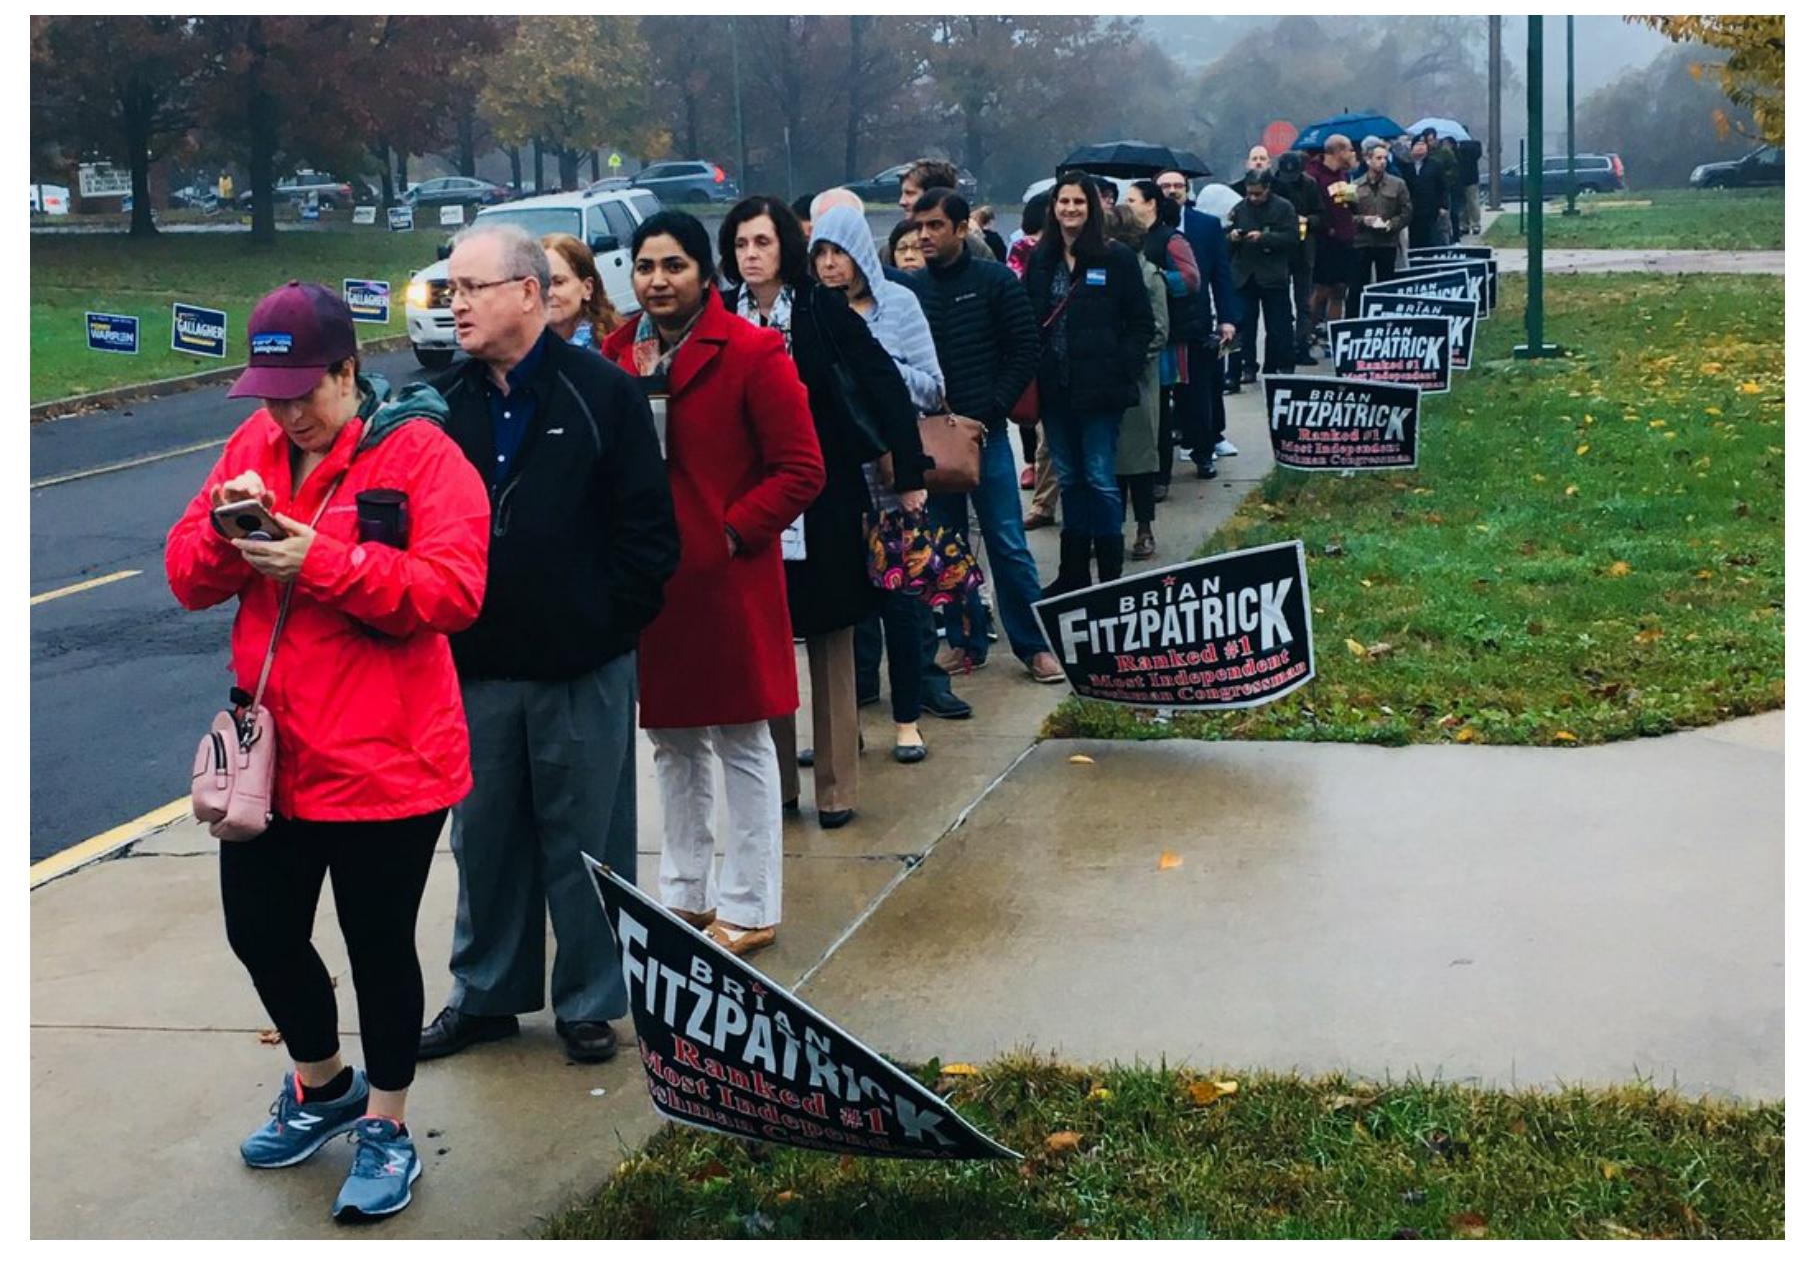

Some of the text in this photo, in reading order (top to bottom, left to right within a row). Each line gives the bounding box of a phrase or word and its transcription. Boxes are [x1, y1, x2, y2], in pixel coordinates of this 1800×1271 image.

[1396, 303, 1442, 315] BRIAN
[1335, 330, 1445, 370] FITZPATRICK
[1364, 326, 1414, 337] BRIAN
[1356, 360, 1404, 371] Ranked
[1271, 388, 1413, 441] FITZPATRICK
[1309, 389, 1372, 403] BRIAN
[1298, 428, 1360, 441] Ranked
[1119, 575, 1221, 614] BRIAN
[1058, 578, 1293, 664] FITZPATRICK
[1088, 649, 1290, 688] Most Independent
[1115, 635, 1254, 673] Ranked #1
[1177, 660, 1306, 702] Congressman
[690, 955, 831, 1054] BRIAN
[617, 906, 957, 1146] FITZPATRICK
[671, 1032, 888, 1135] Ranked #1
